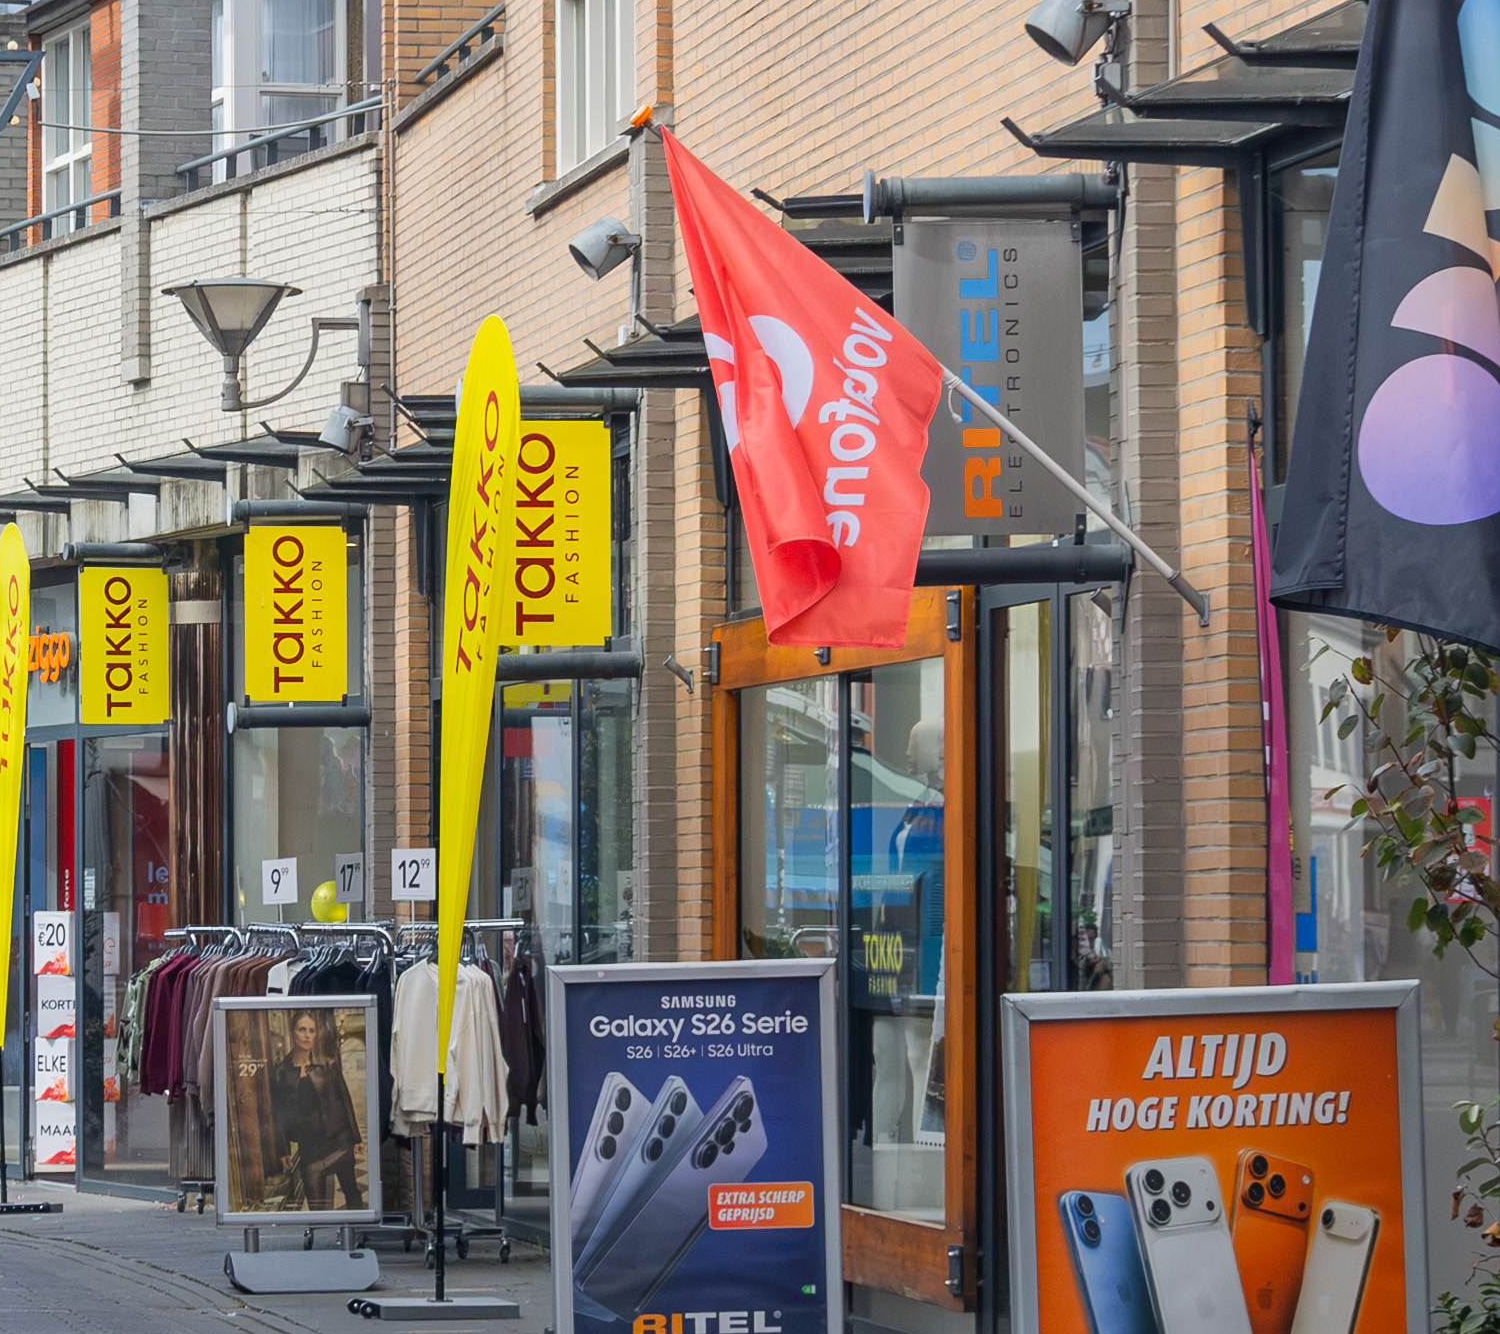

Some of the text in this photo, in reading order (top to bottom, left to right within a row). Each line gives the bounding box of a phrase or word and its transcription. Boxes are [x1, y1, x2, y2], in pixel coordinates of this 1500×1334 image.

[959, 248, 1003, 518] RITEL
[565, 465, 580, 604] FASHION
[311, 560, 323, 669] FASHION
[27, 625, 70, 683] ziggo
[137, 598, 149, 695] FASHION
[37, 922, 66, 947] €20
[660, 994, 737, 1009] SAMSUNG
[589, 1009, 809, 1043] Galaxy S26 Serie
[37, 1054, 67, 1074] ELKE
[626, 1043, 774, 1059] S26 S26+ S26 Ultra
[1141, 1031, 1288, 1091] ALTIJD
[1085, 1090, 1352, 1132] HOGE KORTING!
[40, 1124, 75, 1137] MAA
[716, 1190, 805, 1205] EXTRA SCHERP
[718, 1207, 775, 1224] GEPRIJSD
